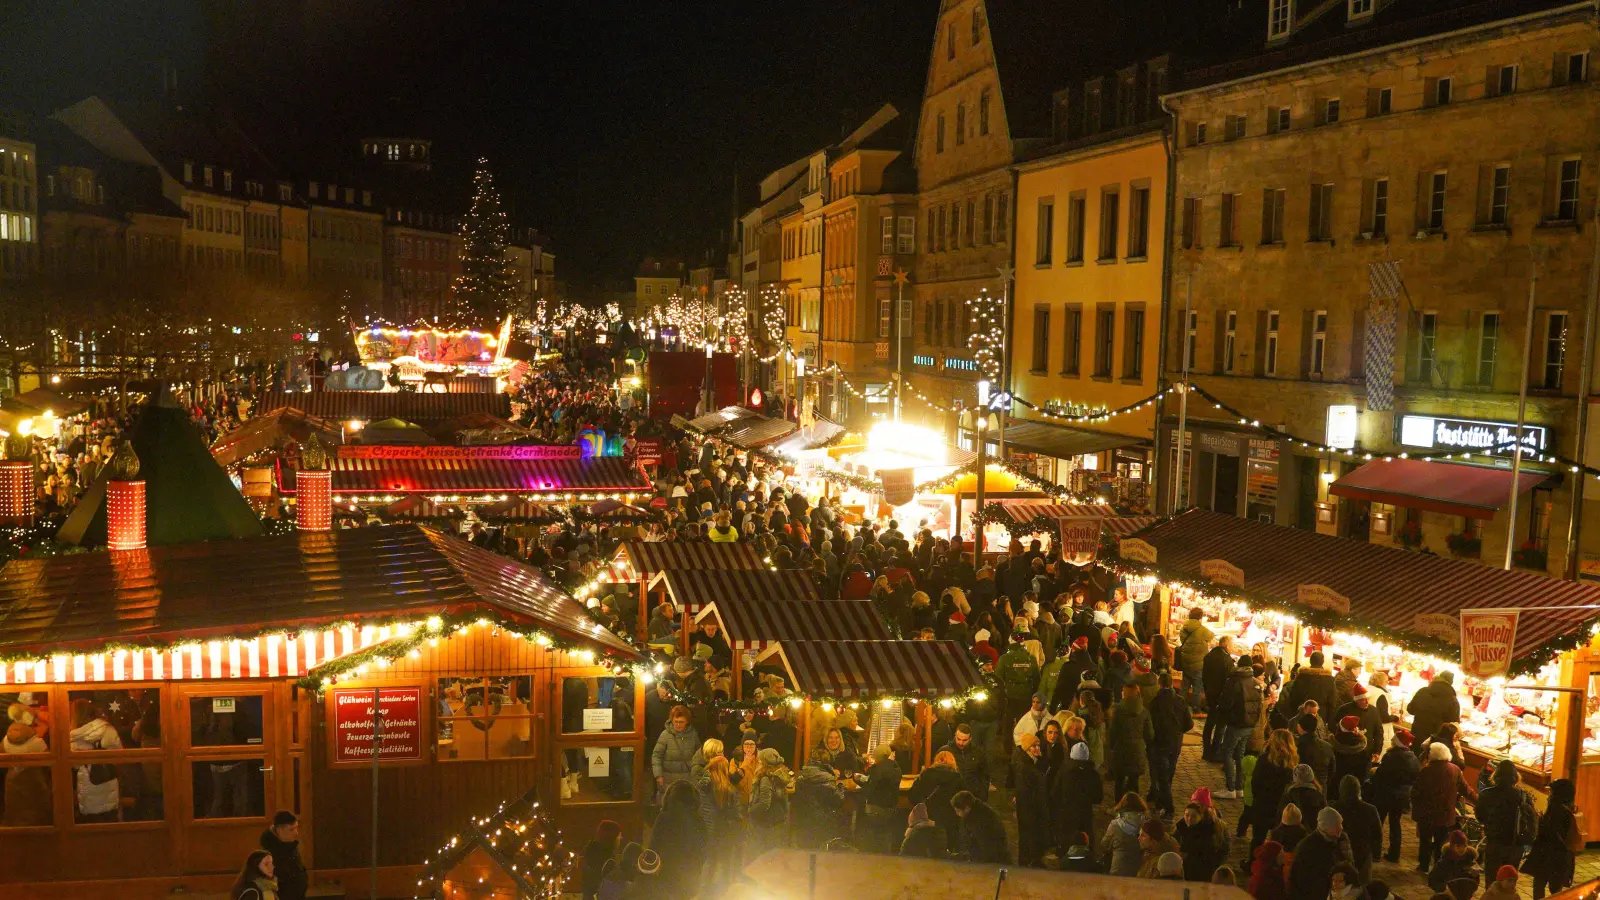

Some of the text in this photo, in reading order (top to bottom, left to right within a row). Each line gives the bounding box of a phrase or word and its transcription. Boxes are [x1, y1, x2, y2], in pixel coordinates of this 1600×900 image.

[1465, 624, 1512, 645] Mandeln
[339, 696, 372, 705] Glühwein
[385, 719, 416, 728] Getränke
[344, 745, 413, 755] Kaffeespzialitäten
